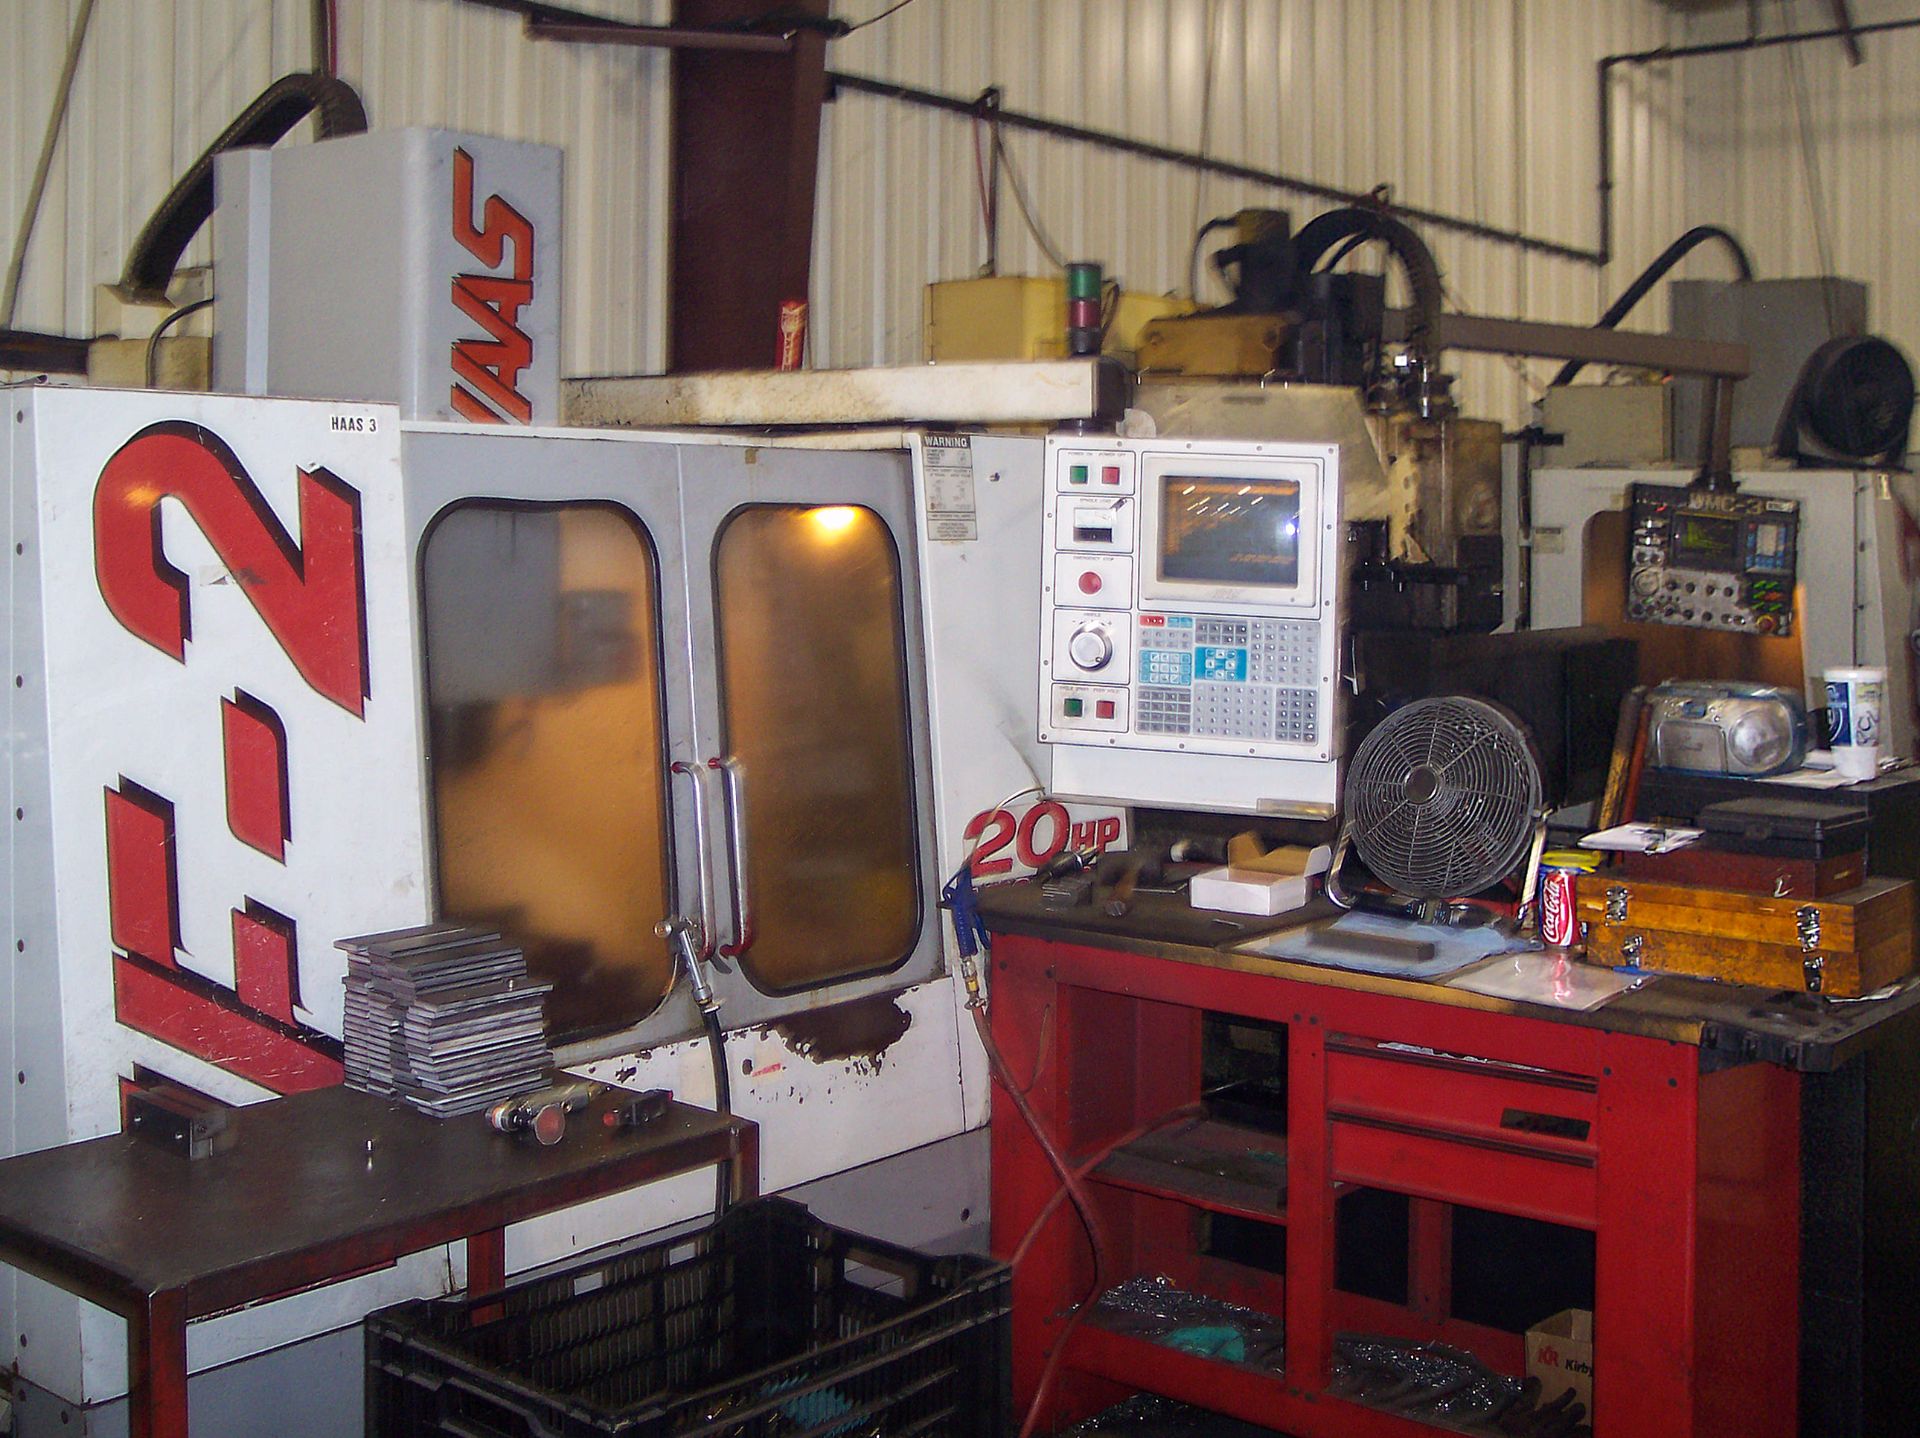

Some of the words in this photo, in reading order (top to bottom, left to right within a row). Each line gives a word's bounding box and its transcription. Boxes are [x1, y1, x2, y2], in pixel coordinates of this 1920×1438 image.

[331, 416, 364, 431] HAAS
[369, 418, 377, 432] 3
[924, 435, 968, 447] WARNING
[94, 420, 370, 1132] F-2
